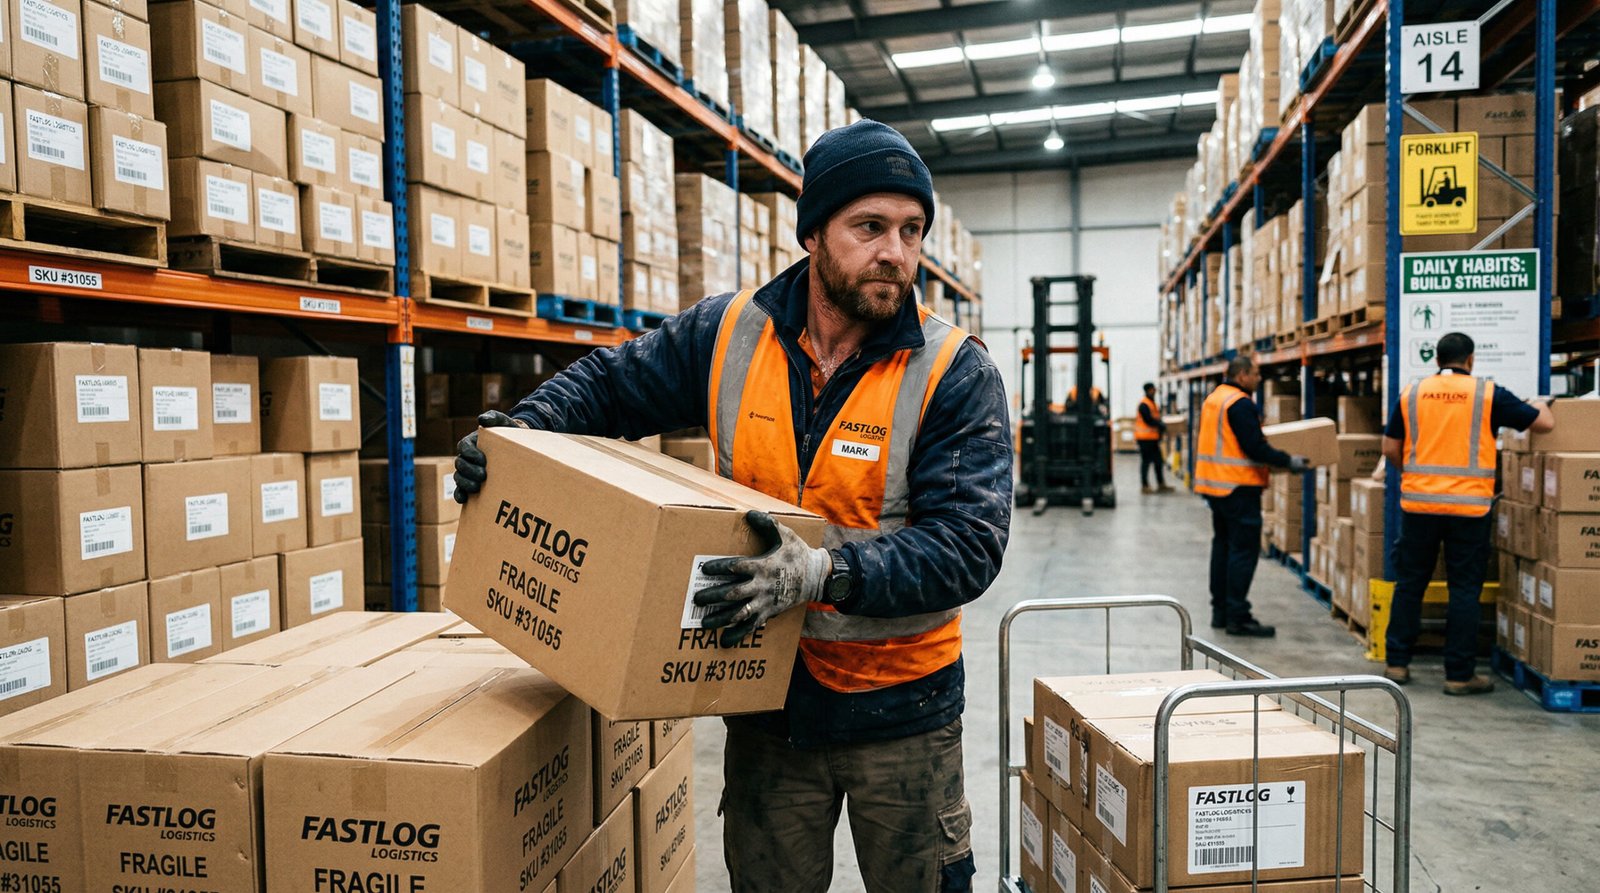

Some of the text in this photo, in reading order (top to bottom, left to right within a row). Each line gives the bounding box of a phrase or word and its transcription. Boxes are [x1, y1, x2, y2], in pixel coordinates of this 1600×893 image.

[1413, 29, 1468, 47] AISLE
[1418, 51, 1464, 83] 14
[1408, 142, 1471, 156] FORKLIFT
[34, 269, 97, 286] SKU #31055
[1412, 256, 1526, 276] DAILY HABITS:
[1410, 274, 1528, 291] BUILD STRENGTH
[839, 421, 887, 436] FASTLOG
[842, 444, 868, 456] MARK
[495, 500, 589, 568] FASTLOG
[532, 549, 580, 584] LOGISTICS
[499, 560, 561, 614] FRAGILE
[486, 588, 562, 650] SKU #31055
[678, 626, 765, 650] FRALE
[660, 660, 766, 683] SKU #31055
[614, 722, 640, 760] FRAGILE
[514, 744, 569, 818] FASTLOG
[611, 763, 623, 788] SKU
[0, 795, 56, 817] TLOG
[656, 776, 687, 834] FASTLOG
[1196, 788, 1270, 805] FASTLOG
[6, 818, 56, 829] LOGISTICS
[106, 804, 216, 830] FASTLOG
[523, 798, 563, 858] FRAGILE
[160, 830, 216, 842] LOGISTICS
[301, 816, 440, 848] FASTLOG
[0, 841, 49, 863] GILE
[370, 848, 439, 862] LOGISTICS
[520, 826, 567, 892] SKU #31055
[120, 852, 208, 878] FRAGILE
[588, 847, 626, 893] STLOG
[0, 872, 61, 893] #31055
[314, 868, 425, 893] FRAGILE
